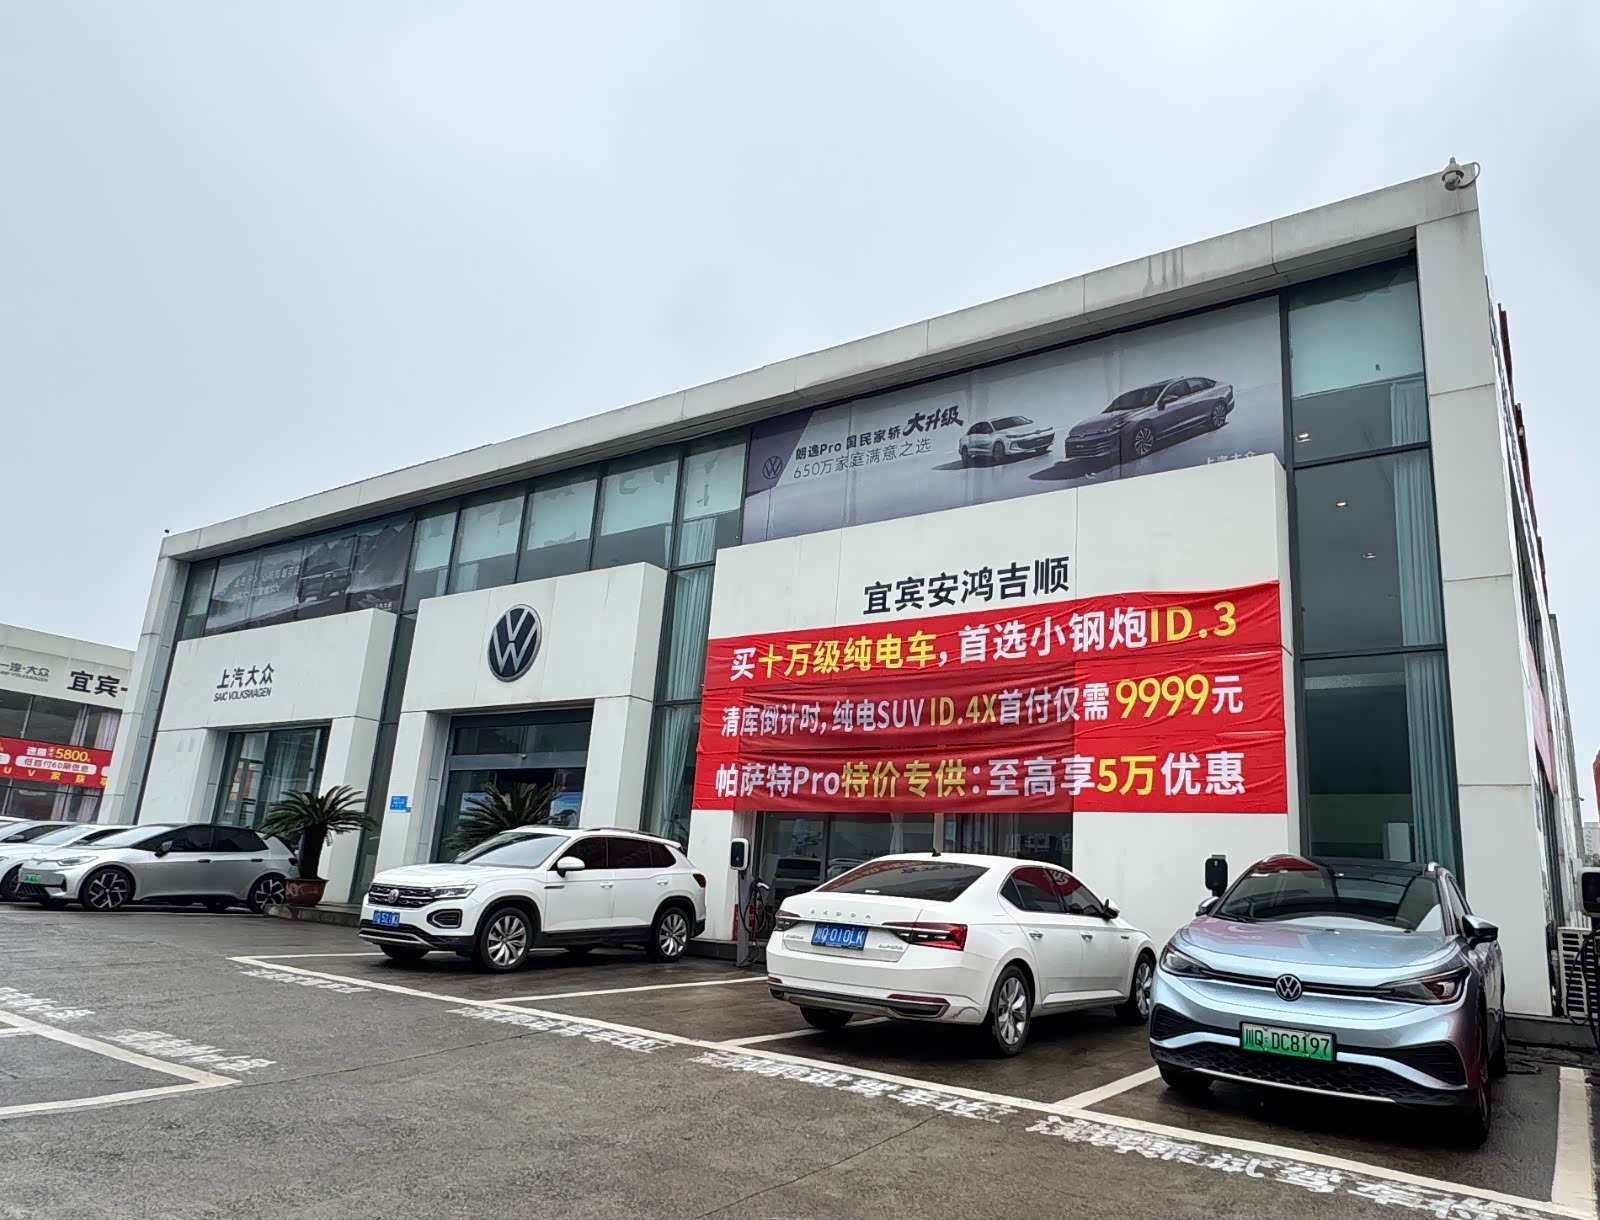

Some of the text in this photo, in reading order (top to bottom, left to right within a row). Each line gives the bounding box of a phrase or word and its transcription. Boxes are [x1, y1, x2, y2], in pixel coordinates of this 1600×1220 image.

[793, 436, 932, 479] 650万家庭满意之选
[795, 443, 842, 461] 朗逸Pro
[902, 405, 964, 437] 大升级
[863, 557, 1070, 615] 宜宾安鸿吉顺
[490, 605, 540, 678] VW
[216, 663, 274, 689] 上汽大众
[229, 687, 272, 700] VOLKSWAGEN
